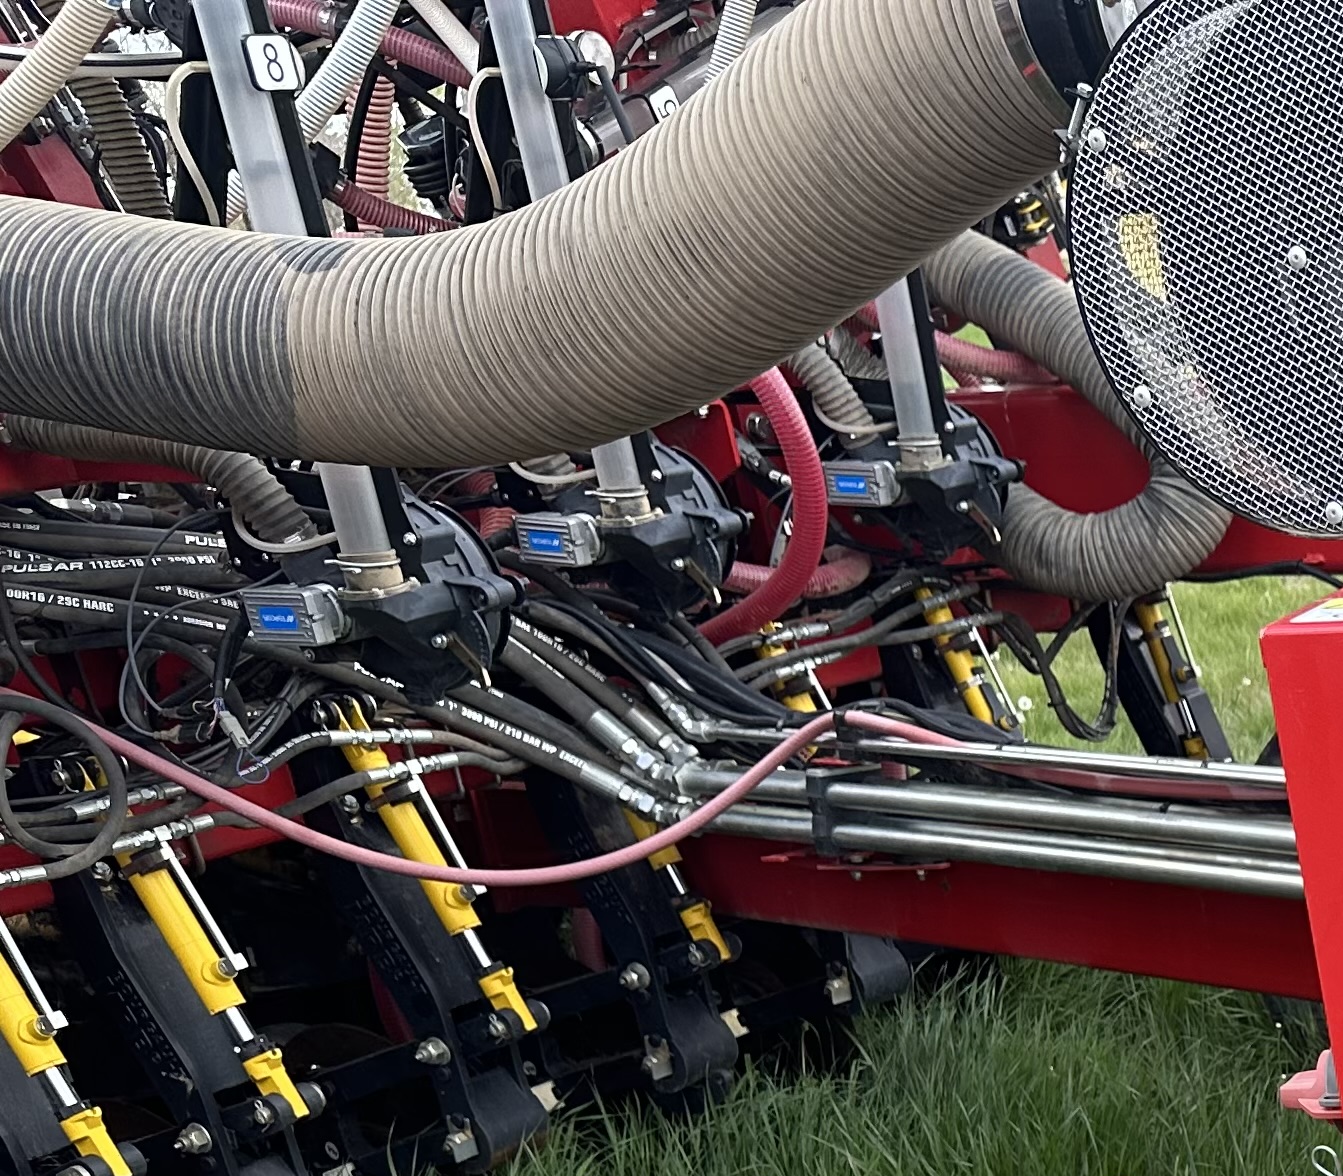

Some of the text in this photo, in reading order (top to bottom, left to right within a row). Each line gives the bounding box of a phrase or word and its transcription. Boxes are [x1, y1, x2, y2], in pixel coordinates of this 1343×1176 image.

[263, 43, 284, 82] 8
[657, 99, 677, 119] 5
[185, 534, 227, 548] PULS
[1, 561, 84, 573] PULSAR
[6, 588, 45, 602] 00R16
